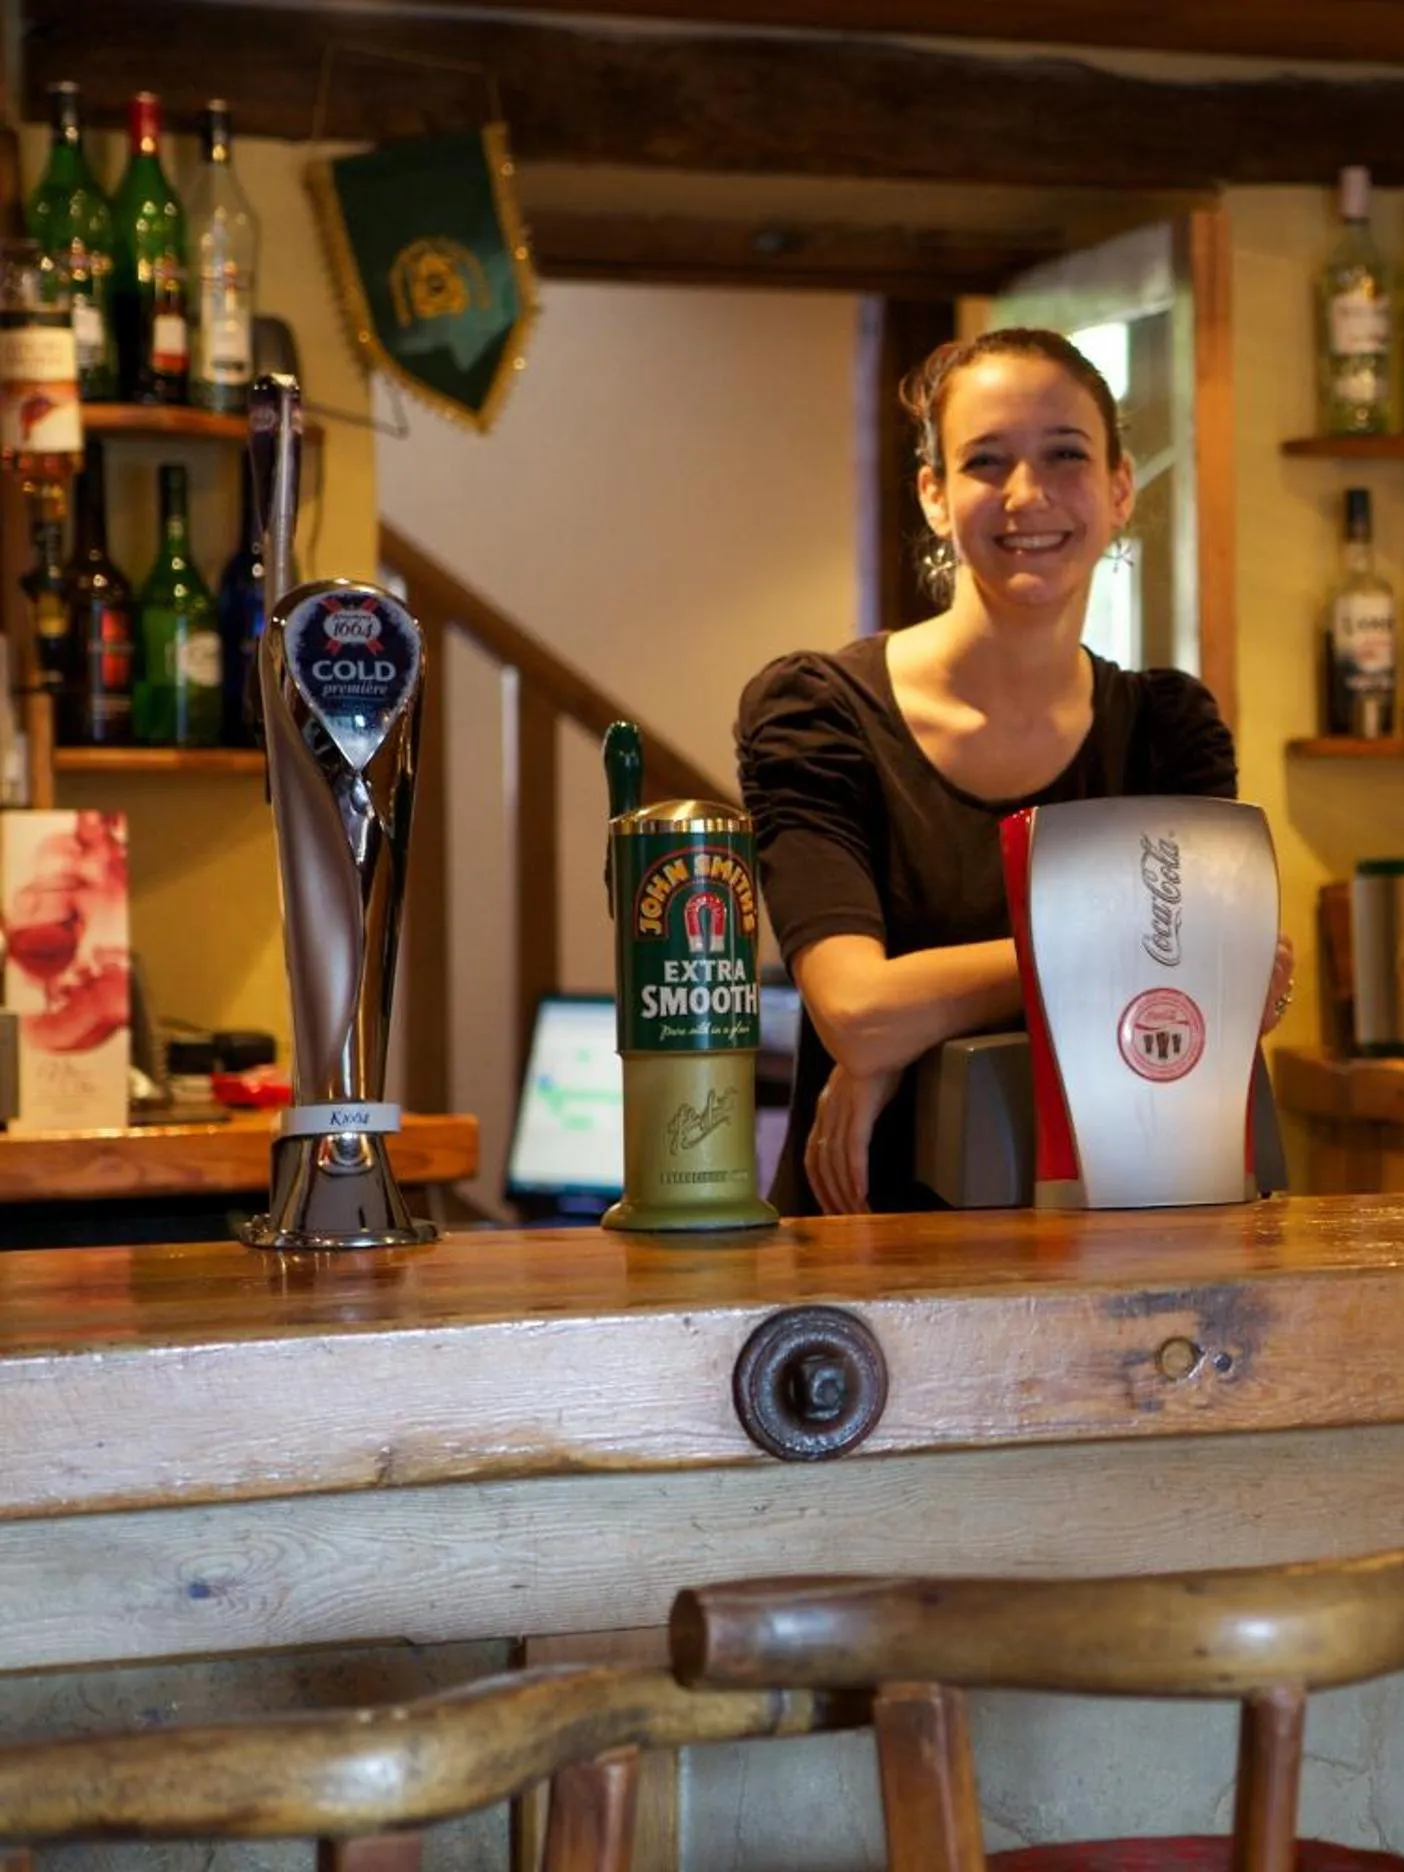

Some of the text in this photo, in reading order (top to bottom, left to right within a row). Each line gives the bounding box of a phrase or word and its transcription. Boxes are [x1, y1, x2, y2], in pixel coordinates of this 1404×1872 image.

[334, 619, 374, 638] 1664
[312, 660, 396, 681] COLD
[639, 858, 689, 936] JOHN
[1139, 830, 1182, 967] Coca-Cola
[664, 958, 746, 983] EXTRA
[641, 983, 757, 1019] SMOOTH
